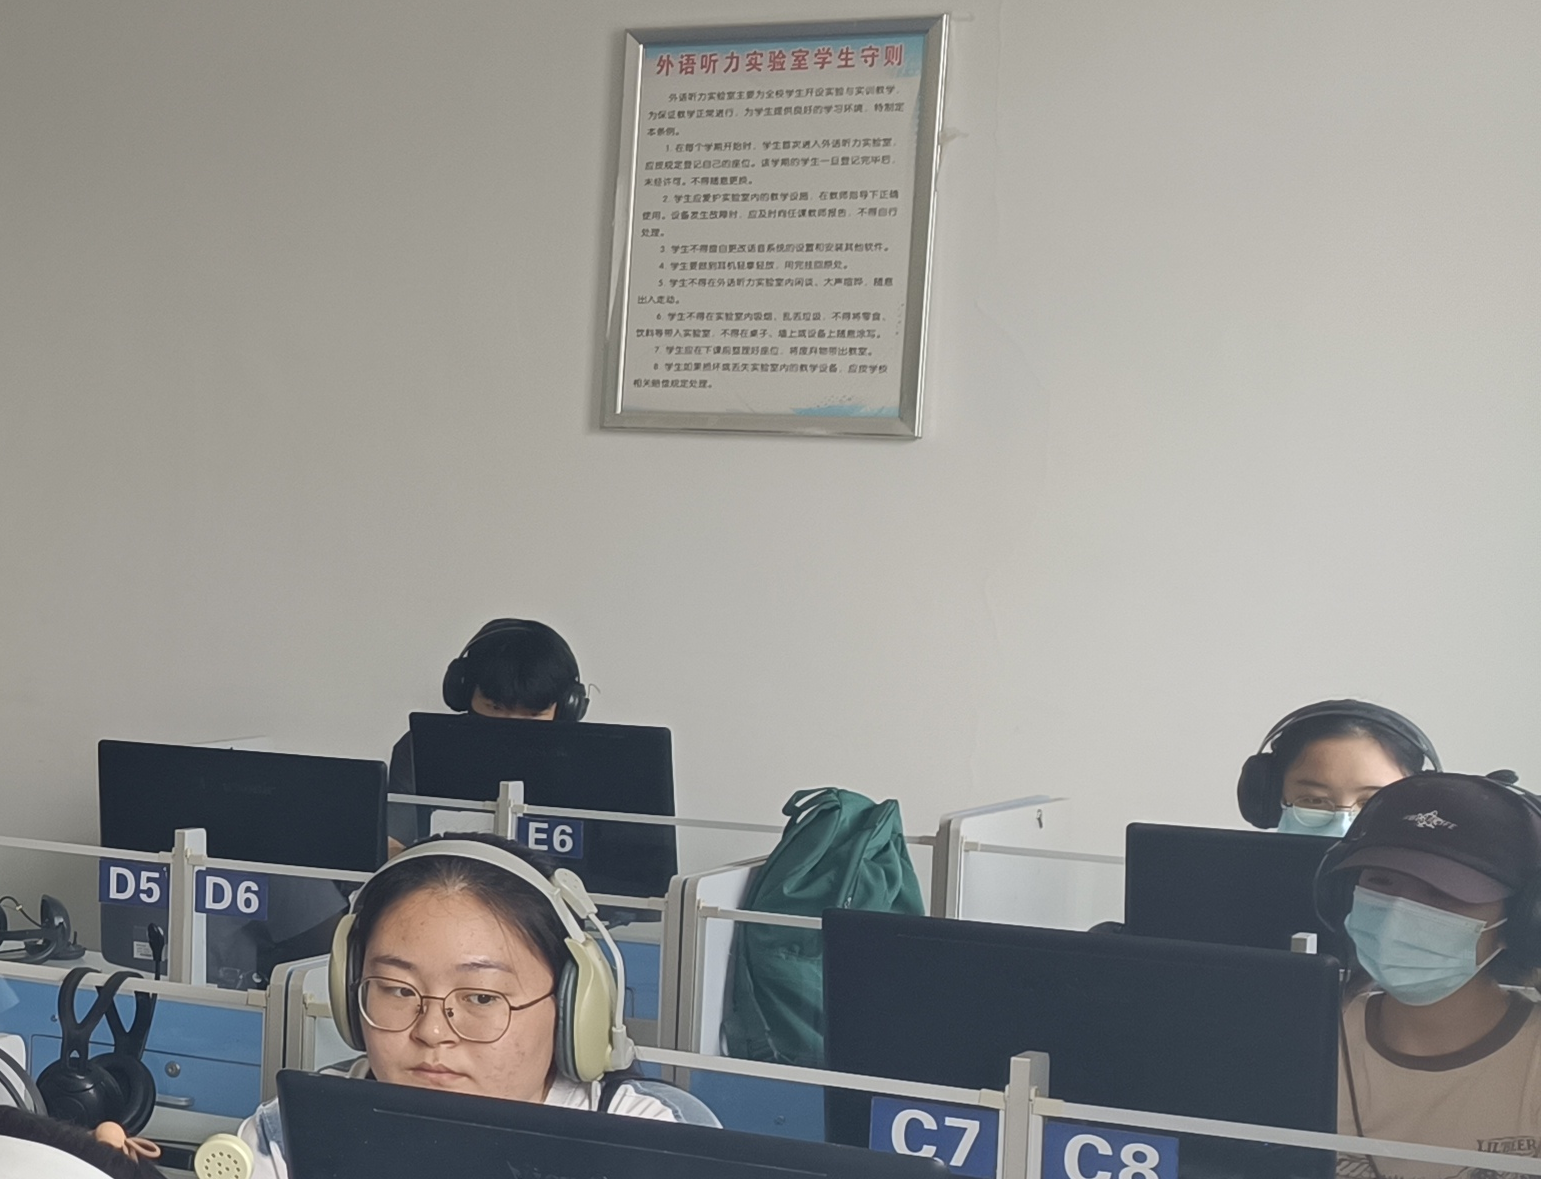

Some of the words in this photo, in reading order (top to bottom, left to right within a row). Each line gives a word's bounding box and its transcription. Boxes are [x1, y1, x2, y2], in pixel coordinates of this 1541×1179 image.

[656, 44, 904, 76] 外语听力实验室学生守则
[640, 227, 665, 238] 处理。
[528, 821, 573, 853] E6
[109, 866, 161, 904] D5
[205, 875, 260, 914] D6
[890, 1108, 981, 1168] C7
